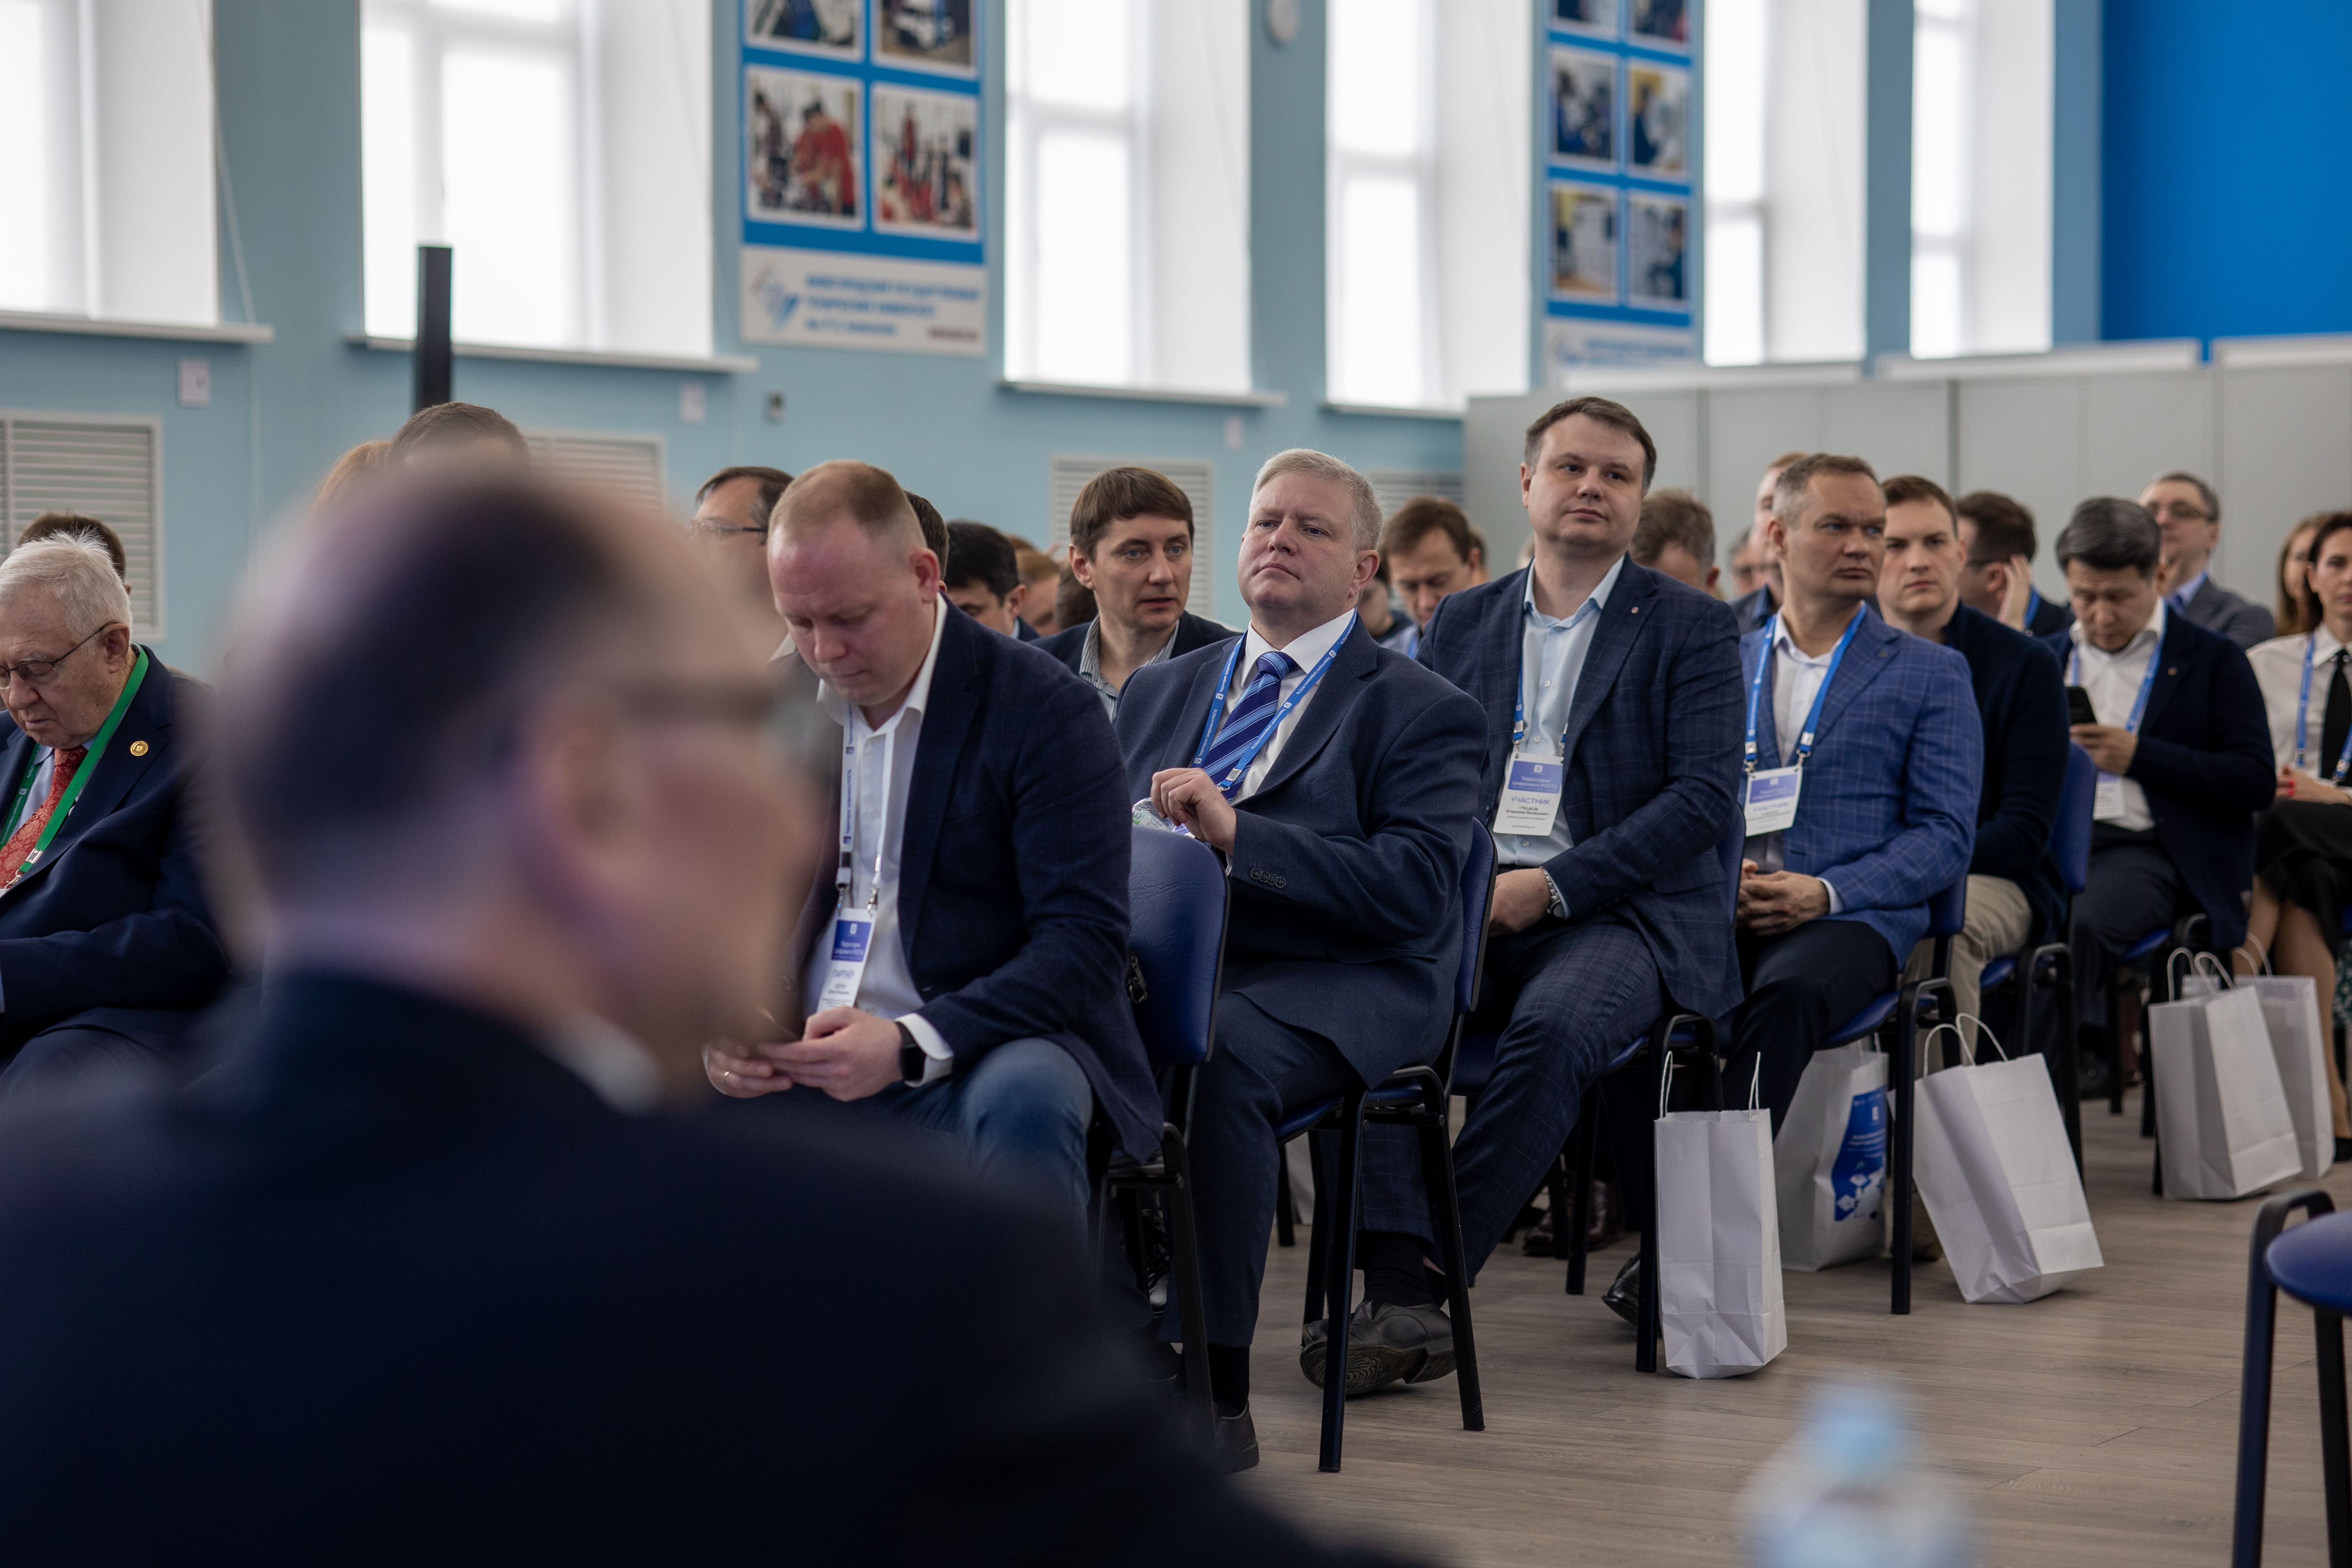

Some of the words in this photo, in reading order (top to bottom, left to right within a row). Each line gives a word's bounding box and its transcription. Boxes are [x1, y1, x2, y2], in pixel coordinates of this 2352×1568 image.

[1316, 656, 1331, 672] Территория
[1304, 671, 1318, 686] Цифрового
[1198, 738, 1208, 757] Территория
[1205, 719, 1214, 738] Цифрового
[1511, 796, 1551, 805] УЧАСТНИК
